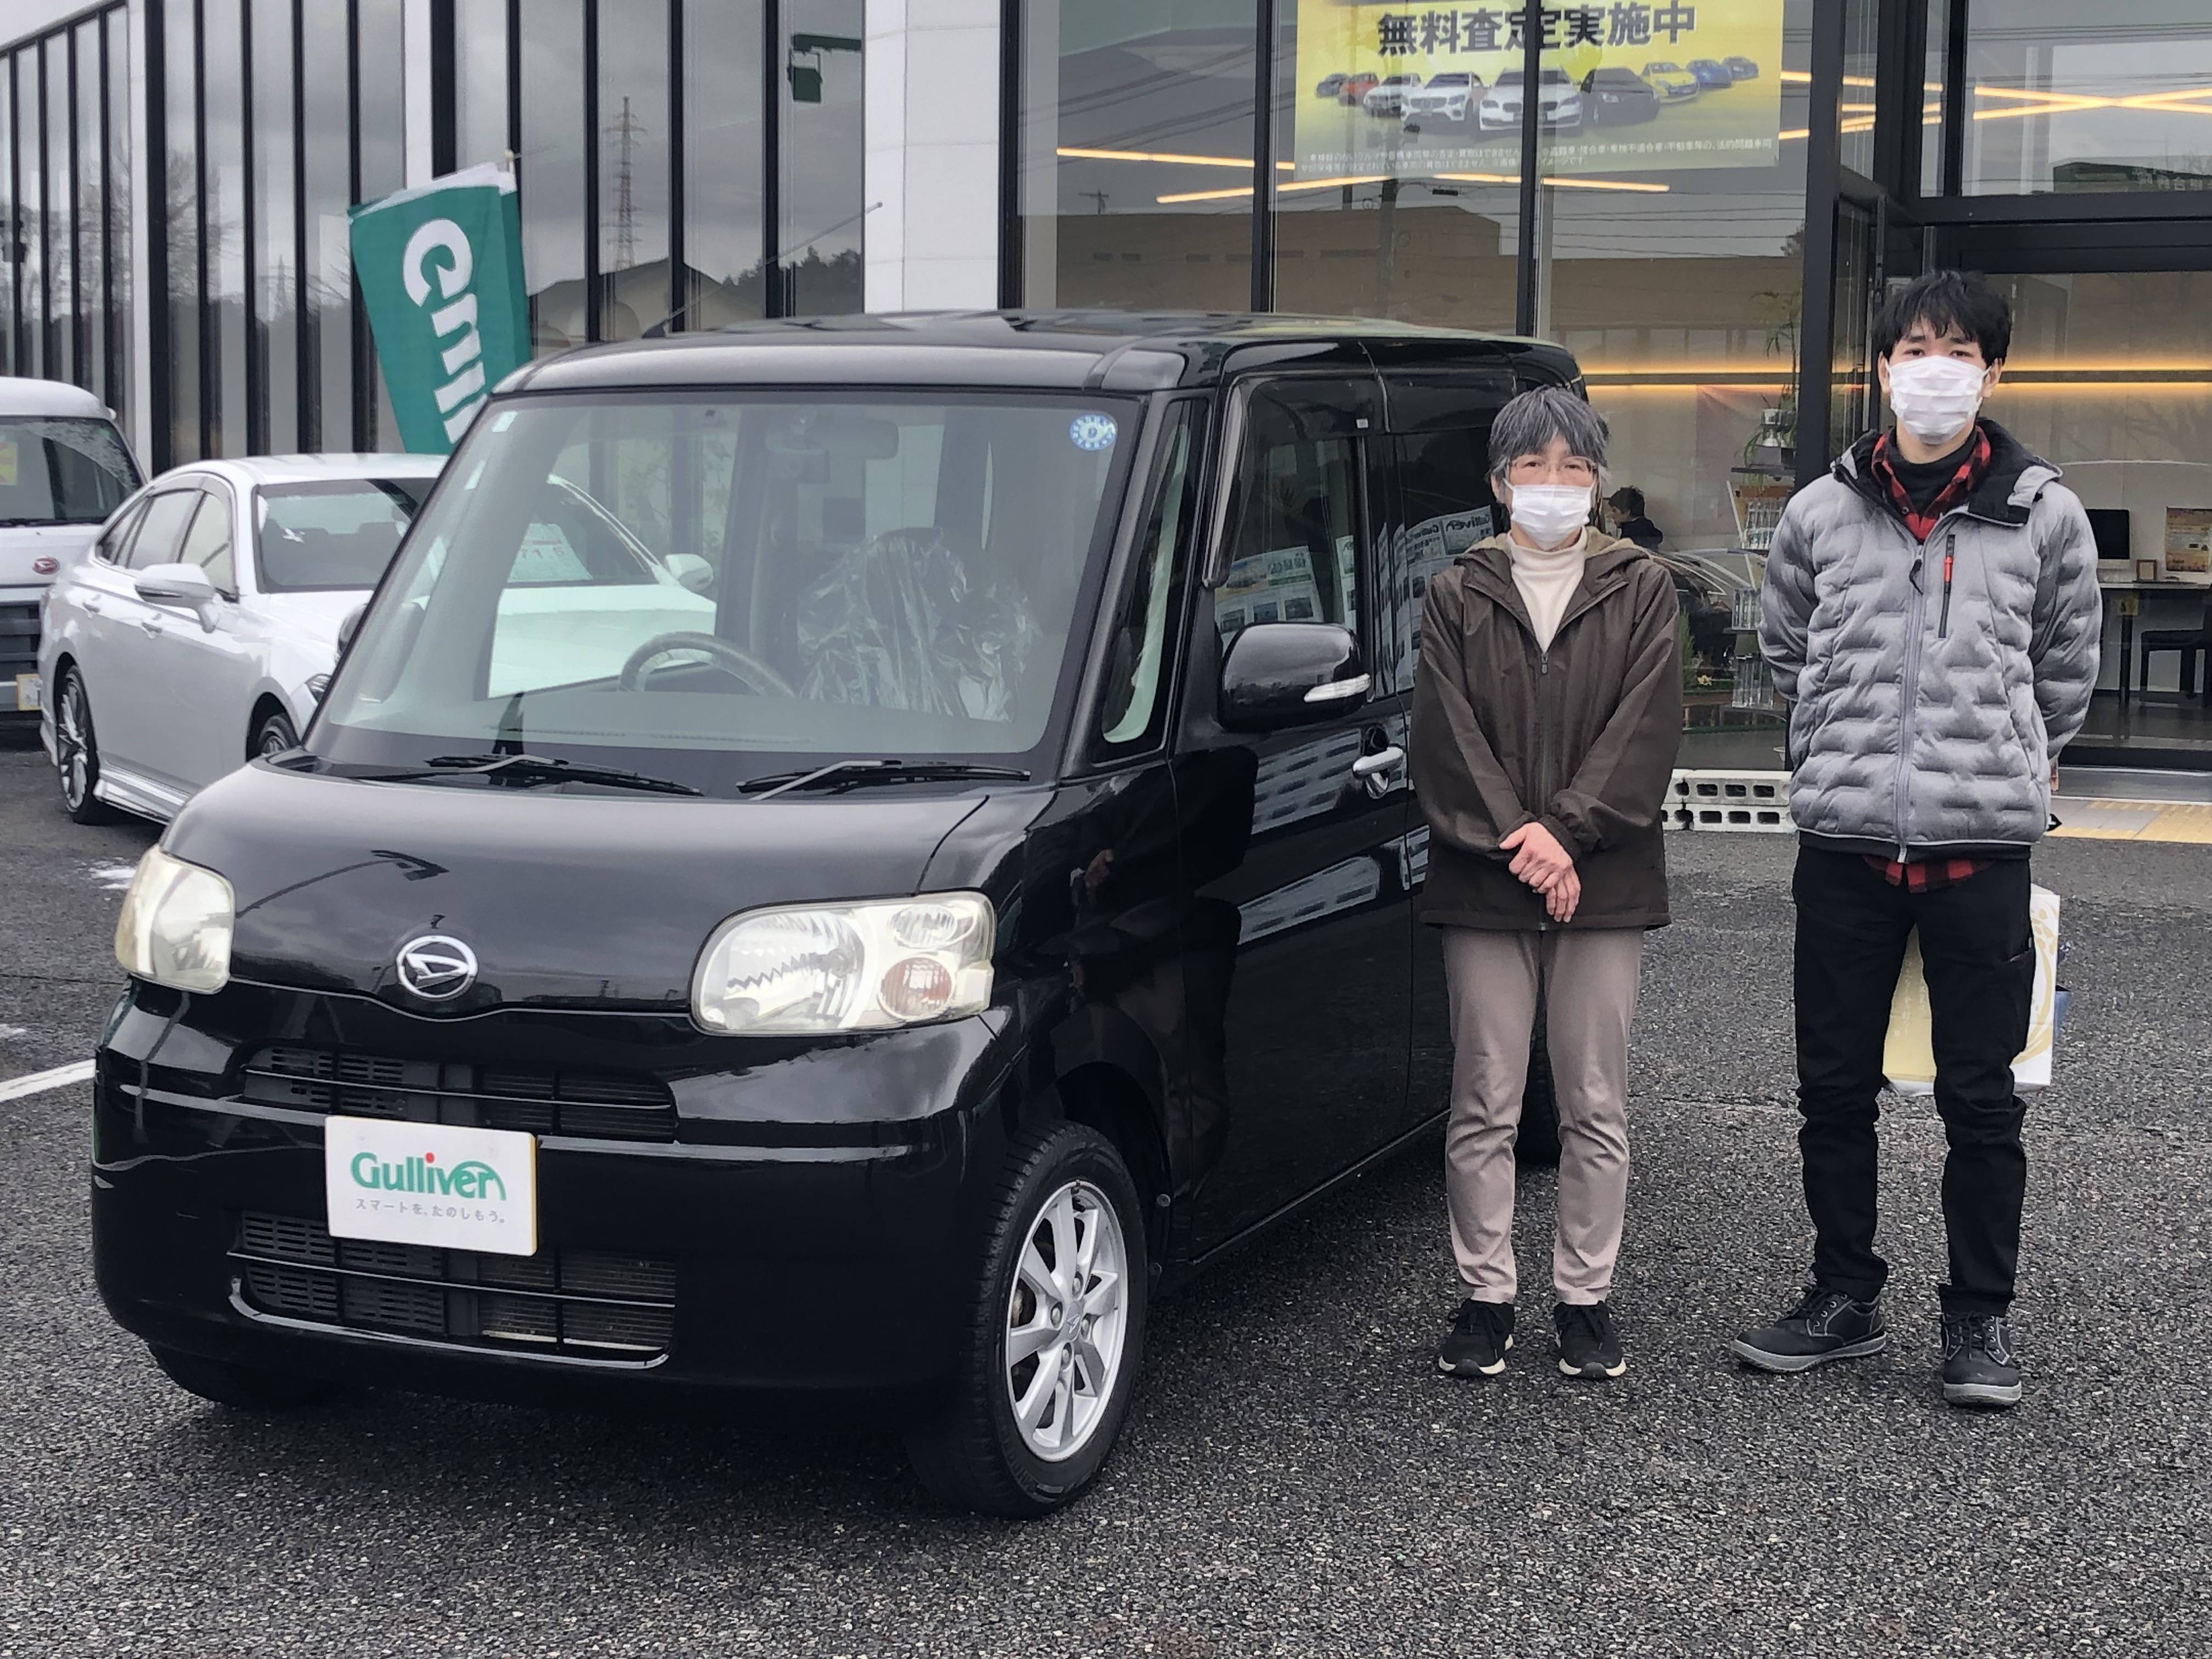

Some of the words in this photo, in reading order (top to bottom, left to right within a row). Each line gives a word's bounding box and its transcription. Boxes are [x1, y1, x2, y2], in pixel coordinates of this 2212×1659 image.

[1378, 0, 1696, 56] 無料査定実施中
[351, 1152, 506, 1201] Gulliver
[356, 1199, 505, 1223] スマートを、たのしもう。
